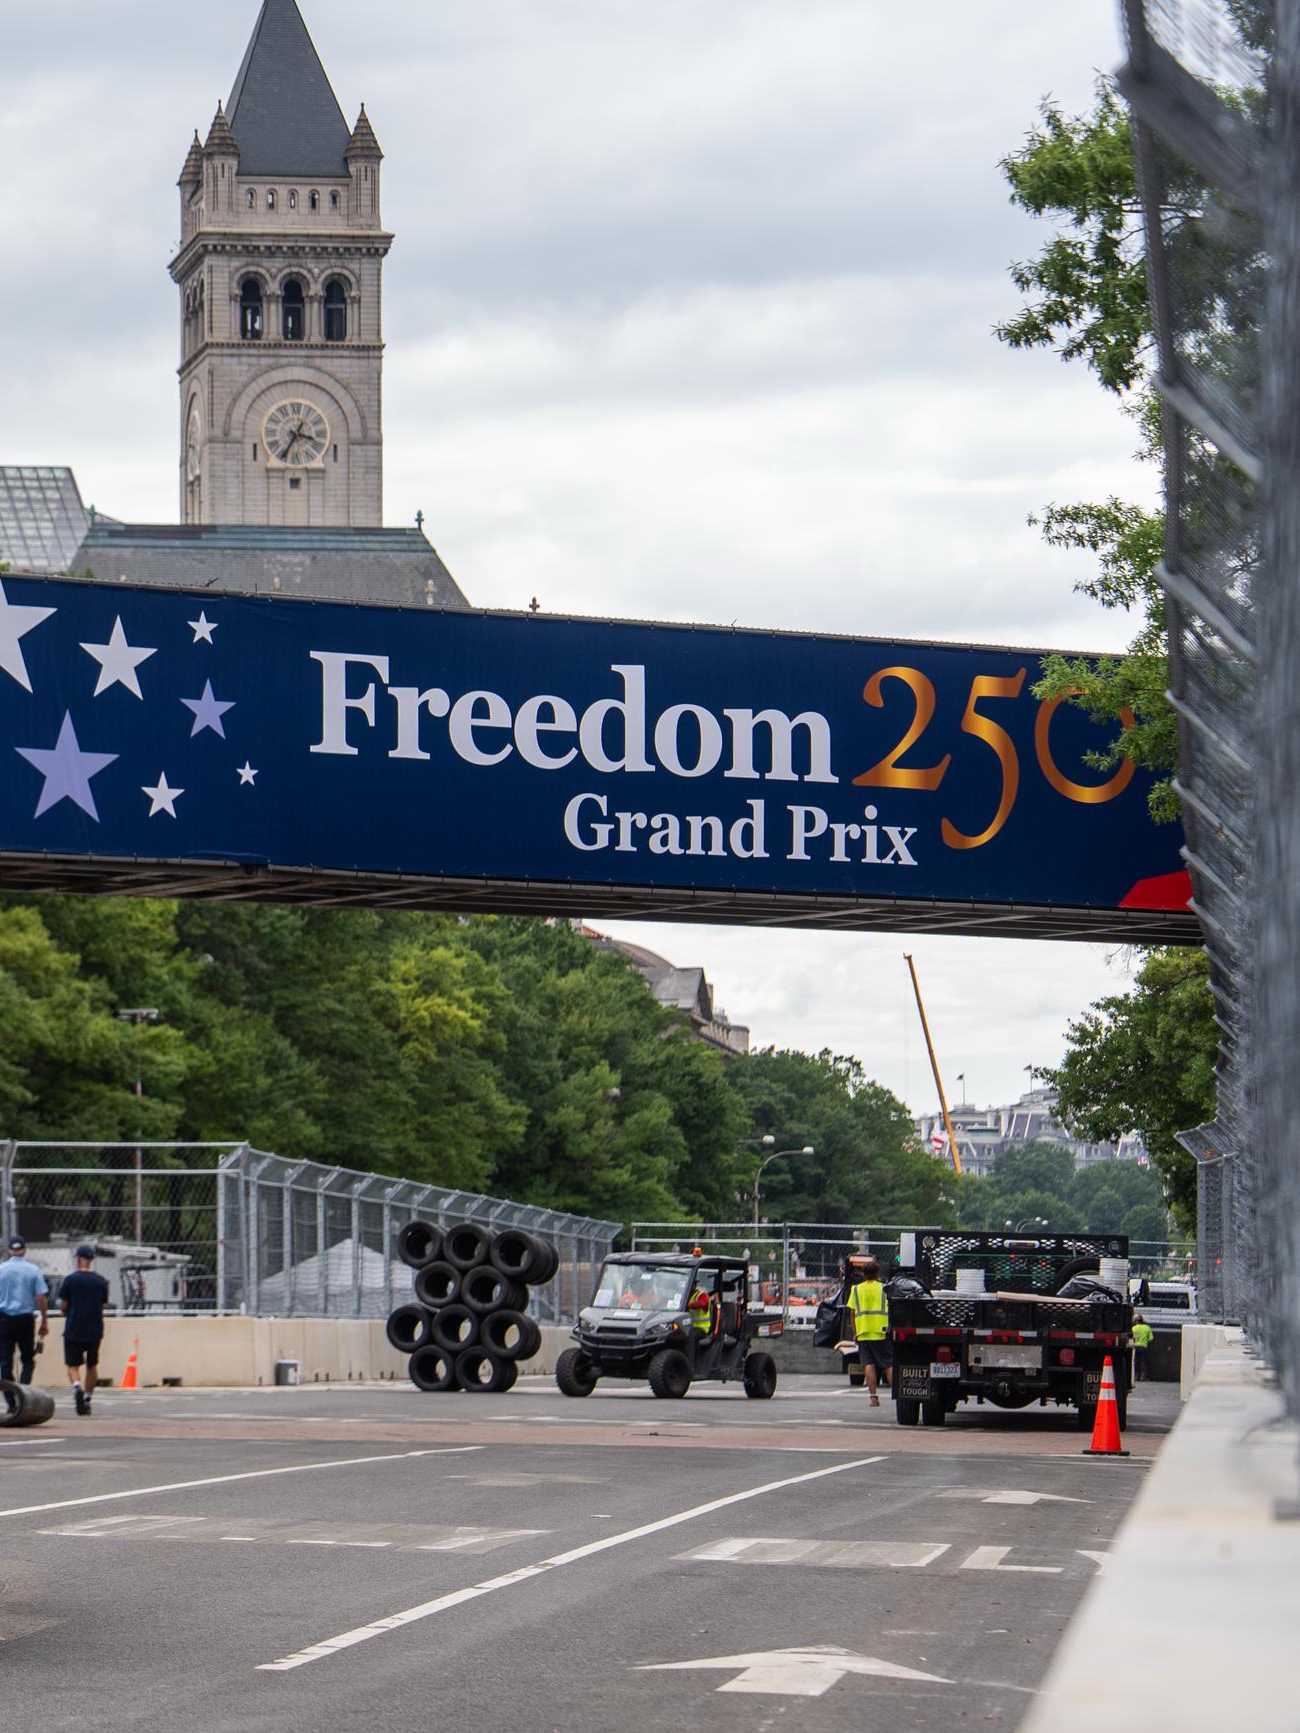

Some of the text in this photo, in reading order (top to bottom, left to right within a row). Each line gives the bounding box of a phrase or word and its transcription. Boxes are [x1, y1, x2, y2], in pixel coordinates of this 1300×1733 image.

[310, 650, 1138, 849] Freedom 250
[564, 793, 918, 866] Grand Prix
[902, 1368, 928, 1378] BUILT
[902, 1387, 928, 1396] TOUGH
